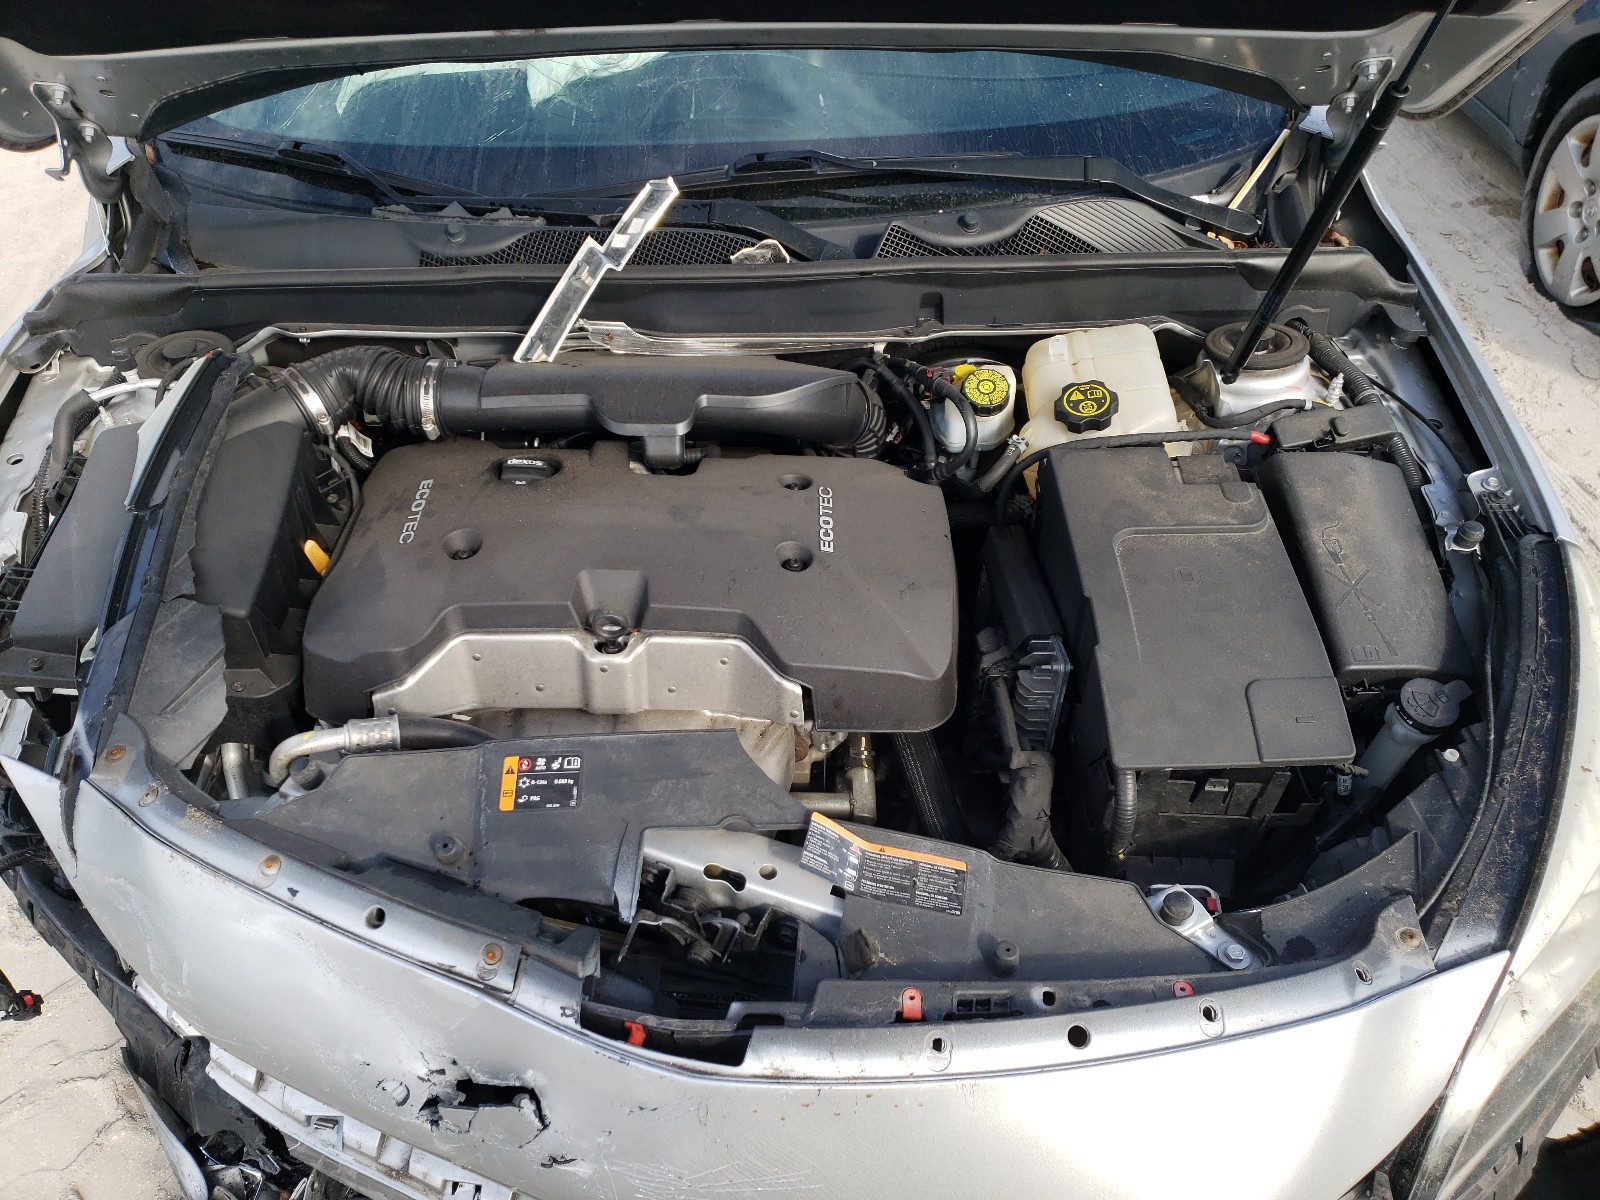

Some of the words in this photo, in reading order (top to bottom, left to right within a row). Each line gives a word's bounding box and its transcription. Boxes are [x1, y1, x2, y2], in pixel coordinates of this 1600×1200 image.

[507, 458, 544, 466] dexos
[399, 478, 434, 545] ECOTEC
[818, 486, 834, 553] ECOTEC
